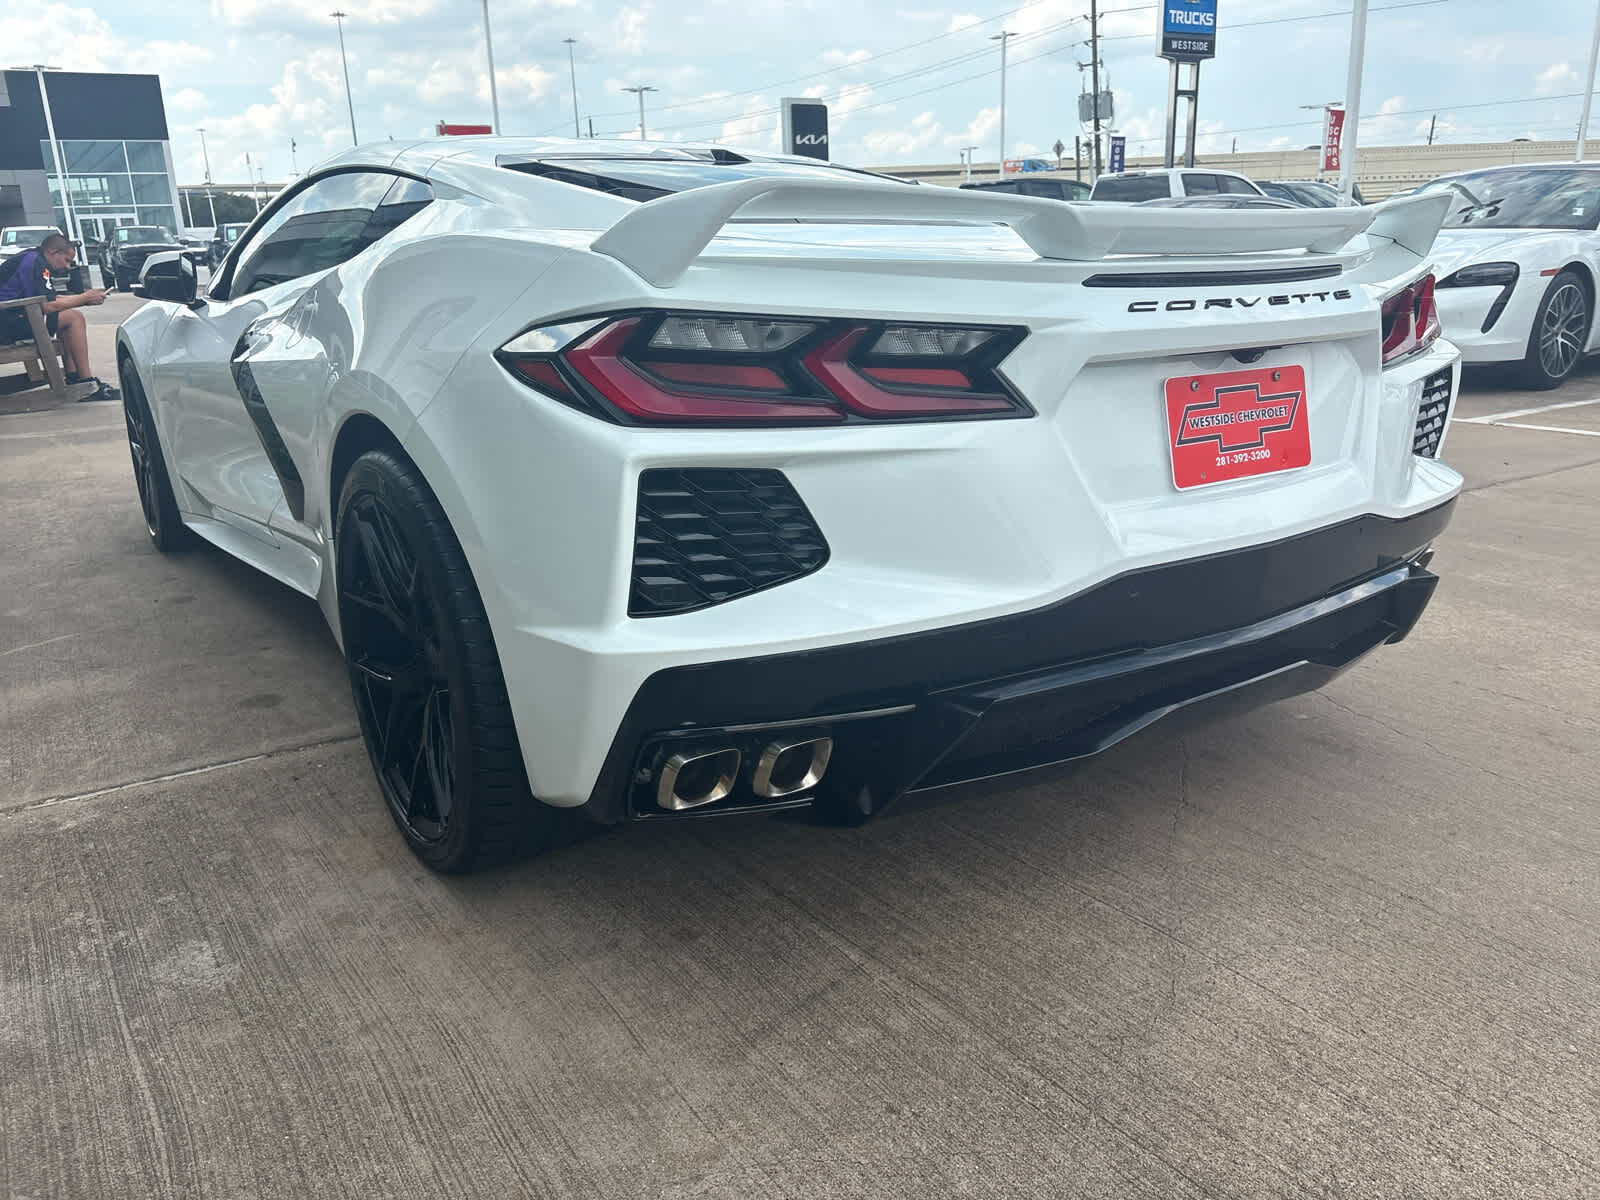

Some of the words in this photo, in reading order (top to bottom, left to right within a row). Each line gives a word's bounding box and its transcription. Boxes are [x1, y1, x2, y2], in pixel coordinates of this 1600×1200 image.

[1169, 10, 1214, 26] TRUCKS
[1171, 40, 1208, 51] WESTSIDE
[796, 134, 827, 145] KIA
[1128, 290, 1352, 312] CORVETTE
[1188, 412, 1235, 429] WESTSIDE
[1237, 405, 1289, 422] CHEVROLET
[1216, 449, 1271, 466] 281-392-3200
